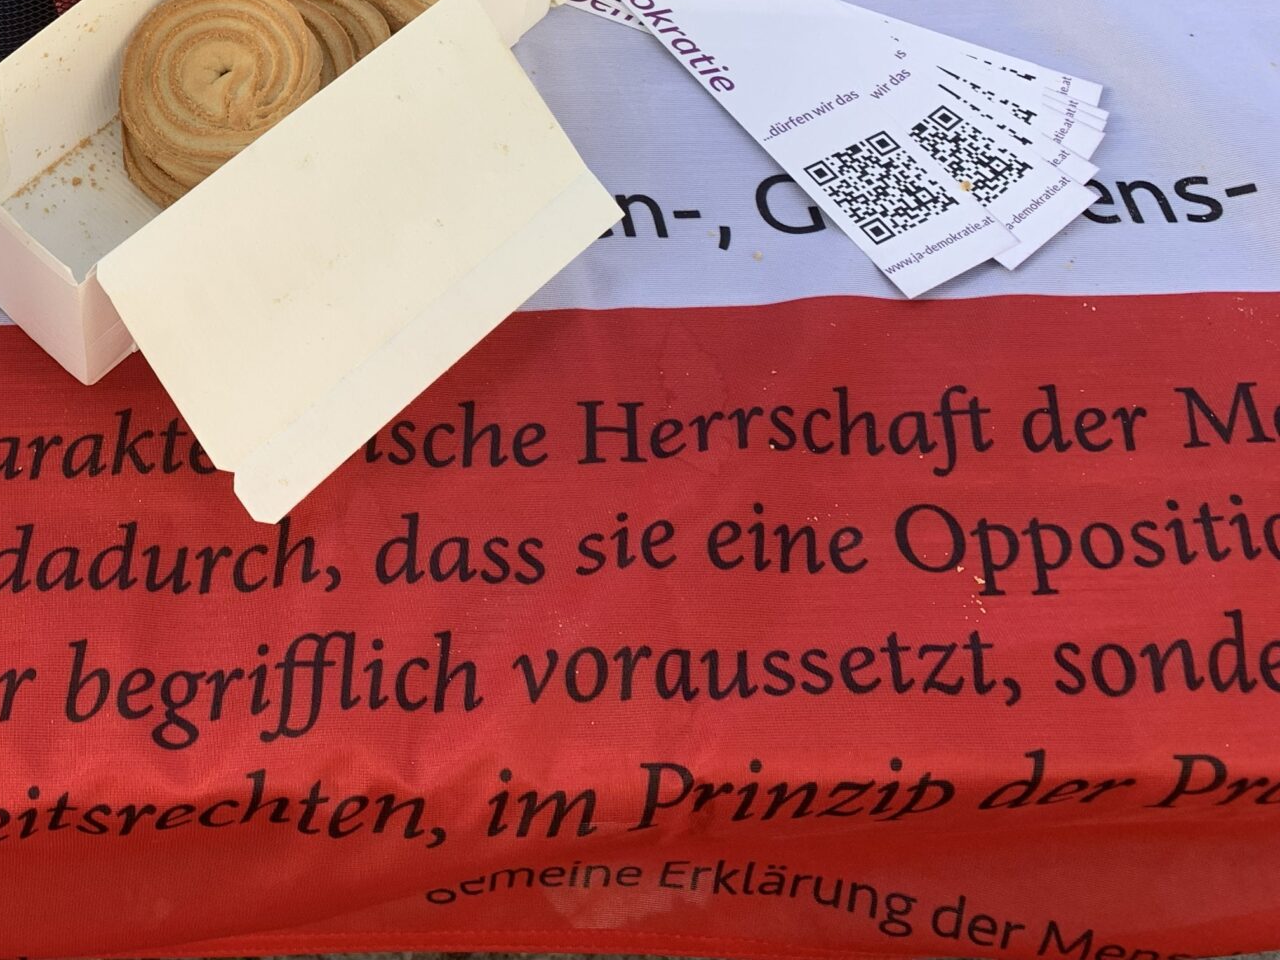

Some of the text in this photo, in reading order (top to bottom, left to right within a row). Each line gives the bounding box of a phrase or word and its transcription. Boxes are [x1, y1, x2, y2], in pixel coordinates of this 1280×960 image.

[811, 100, 836, 117] wir
[835, 90, 860, 107] das
[1080, 176, 1258, 227] ens-
[884, 214, 995, 276] www.ja-demokratie.at
[577, 384, 994, 477] Herrschaft
[1022, 384, 1147, 453] der
[376, 513, 546, 585] dass
[575, 513, 677, 576] sie
[707, 502, 869, 574] eine
[65, 630, 483, 751] begrifflich
[512, 630, 1022, 707] voraussetzt,
[487, 769, 597, 839] im
[628, 758, 956, 832] Prinzip
[978, 749, 1137, 811] der
[658, 859, 918, 938] Erklärung
[931, 895, 1026, 951] der
